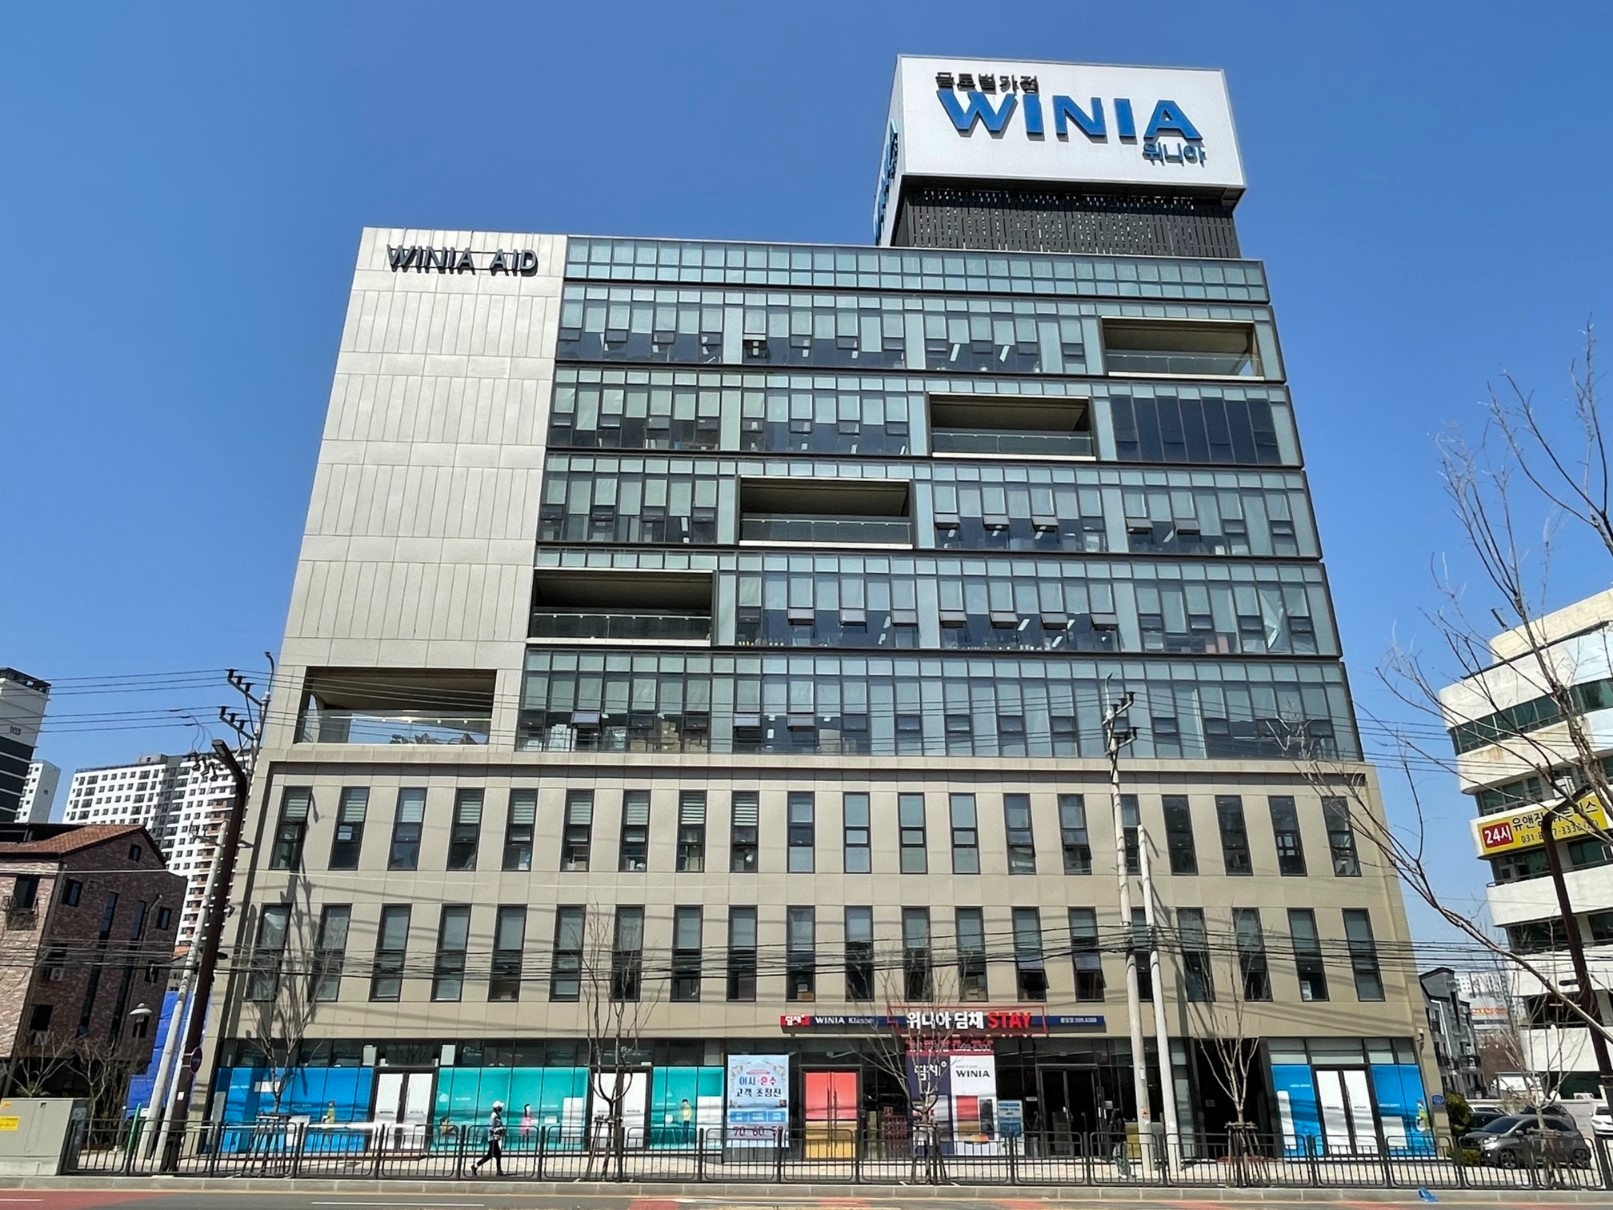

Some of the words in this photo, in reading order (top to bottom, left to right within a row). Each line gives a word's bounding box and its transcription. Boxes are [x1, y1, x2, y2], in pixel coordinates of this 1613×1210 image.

[935, 72, 1039, 95] 글로벌가전
[937, 90, 1203, 141] WINIA
[1142, 141, 1207, 166] 위니아
[387, 244, 475, 273] WINIA
[490, 248, 538, 275] AID
[1484, 825, 1512, 844] 24시
[815, 1016, 845, 1024] WINIA
[906, 1011, 951, 1029] 위니아
[954, 1011, 984, 1029] 딤채
[987, 1011, 1032, 1029] STAY
[956, 1070, 990, 1078] WINIA
